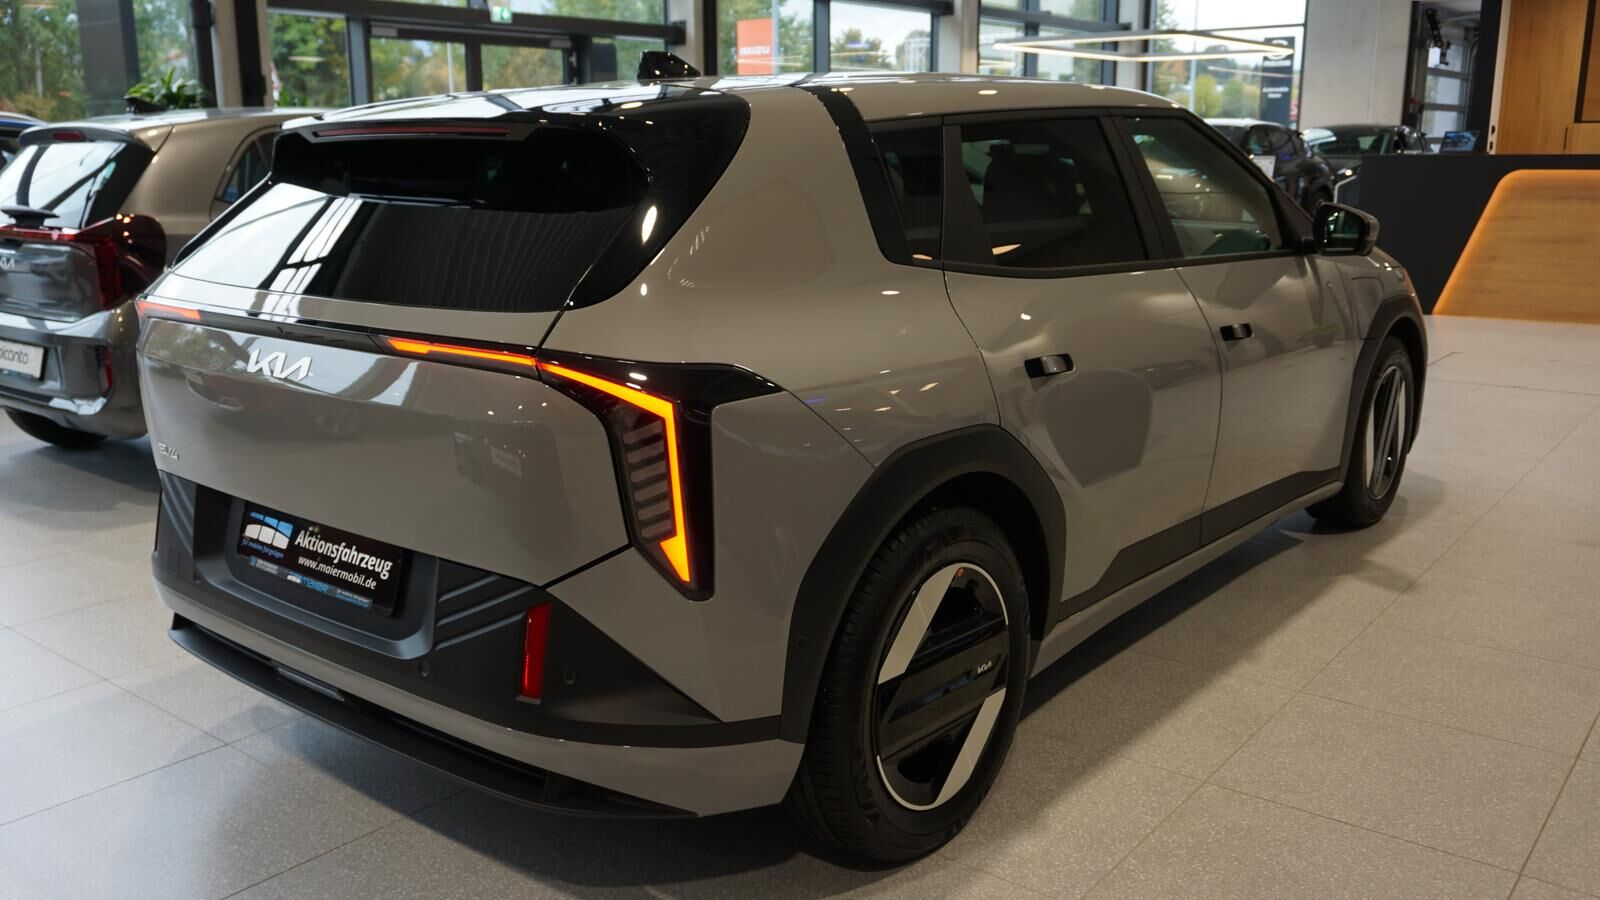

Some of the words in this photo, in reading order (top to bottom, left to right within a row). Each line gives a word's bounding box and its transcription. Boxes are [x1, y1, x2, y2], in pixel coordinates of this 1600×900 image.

[246, 348, 312, 382] KIA
[159, 443, 178, 460] EV4
[294, 529, 393, 580] Aktionsfahrzeug
[298, 556, 377, 590] www.maiermobil.de
